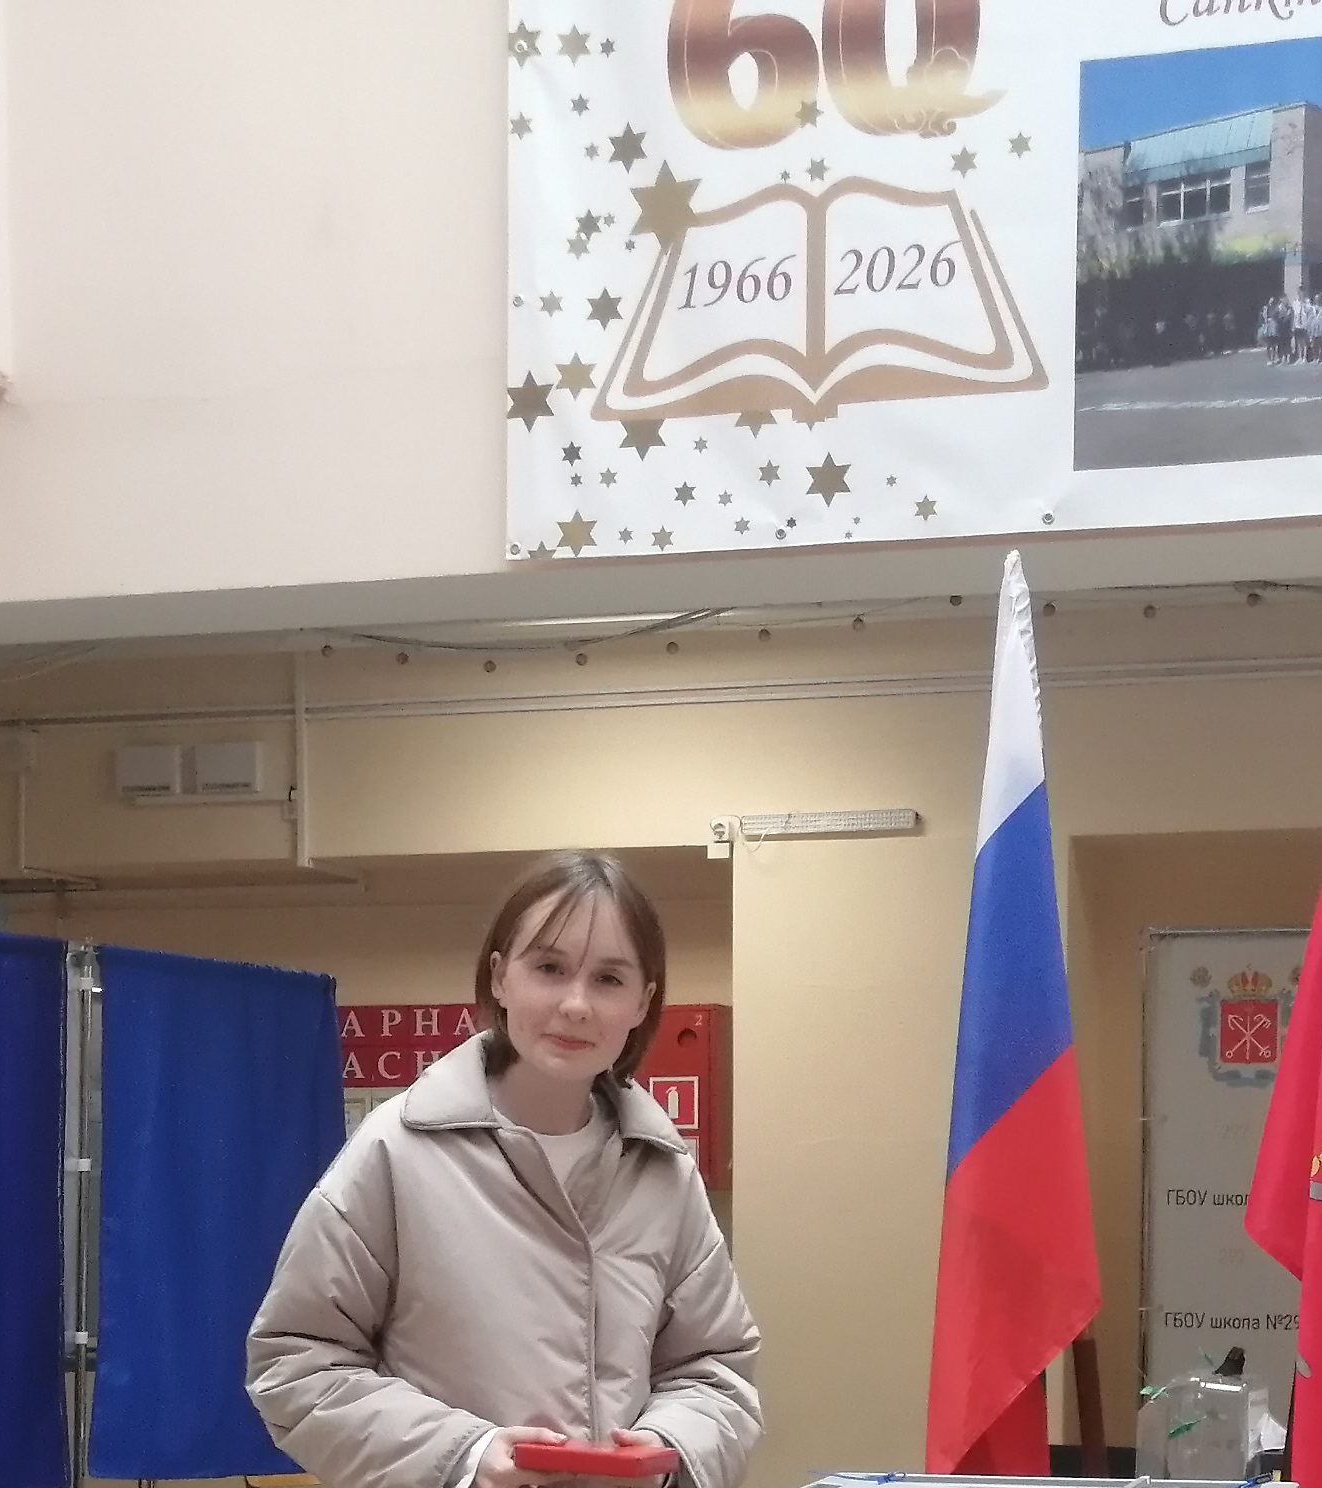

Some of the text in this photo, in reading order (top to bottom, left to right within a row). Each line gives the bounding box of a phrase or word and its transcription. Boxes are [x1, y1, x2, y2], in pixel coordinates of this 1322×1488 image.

[677, 239, 963, 311] 1966 2026
[1166, 1188, 1208, 1207] ГБОУ
[1164, 1311, 1206, 1328] ГБОУ
[1209, 1316, 1261, 1331] школа
